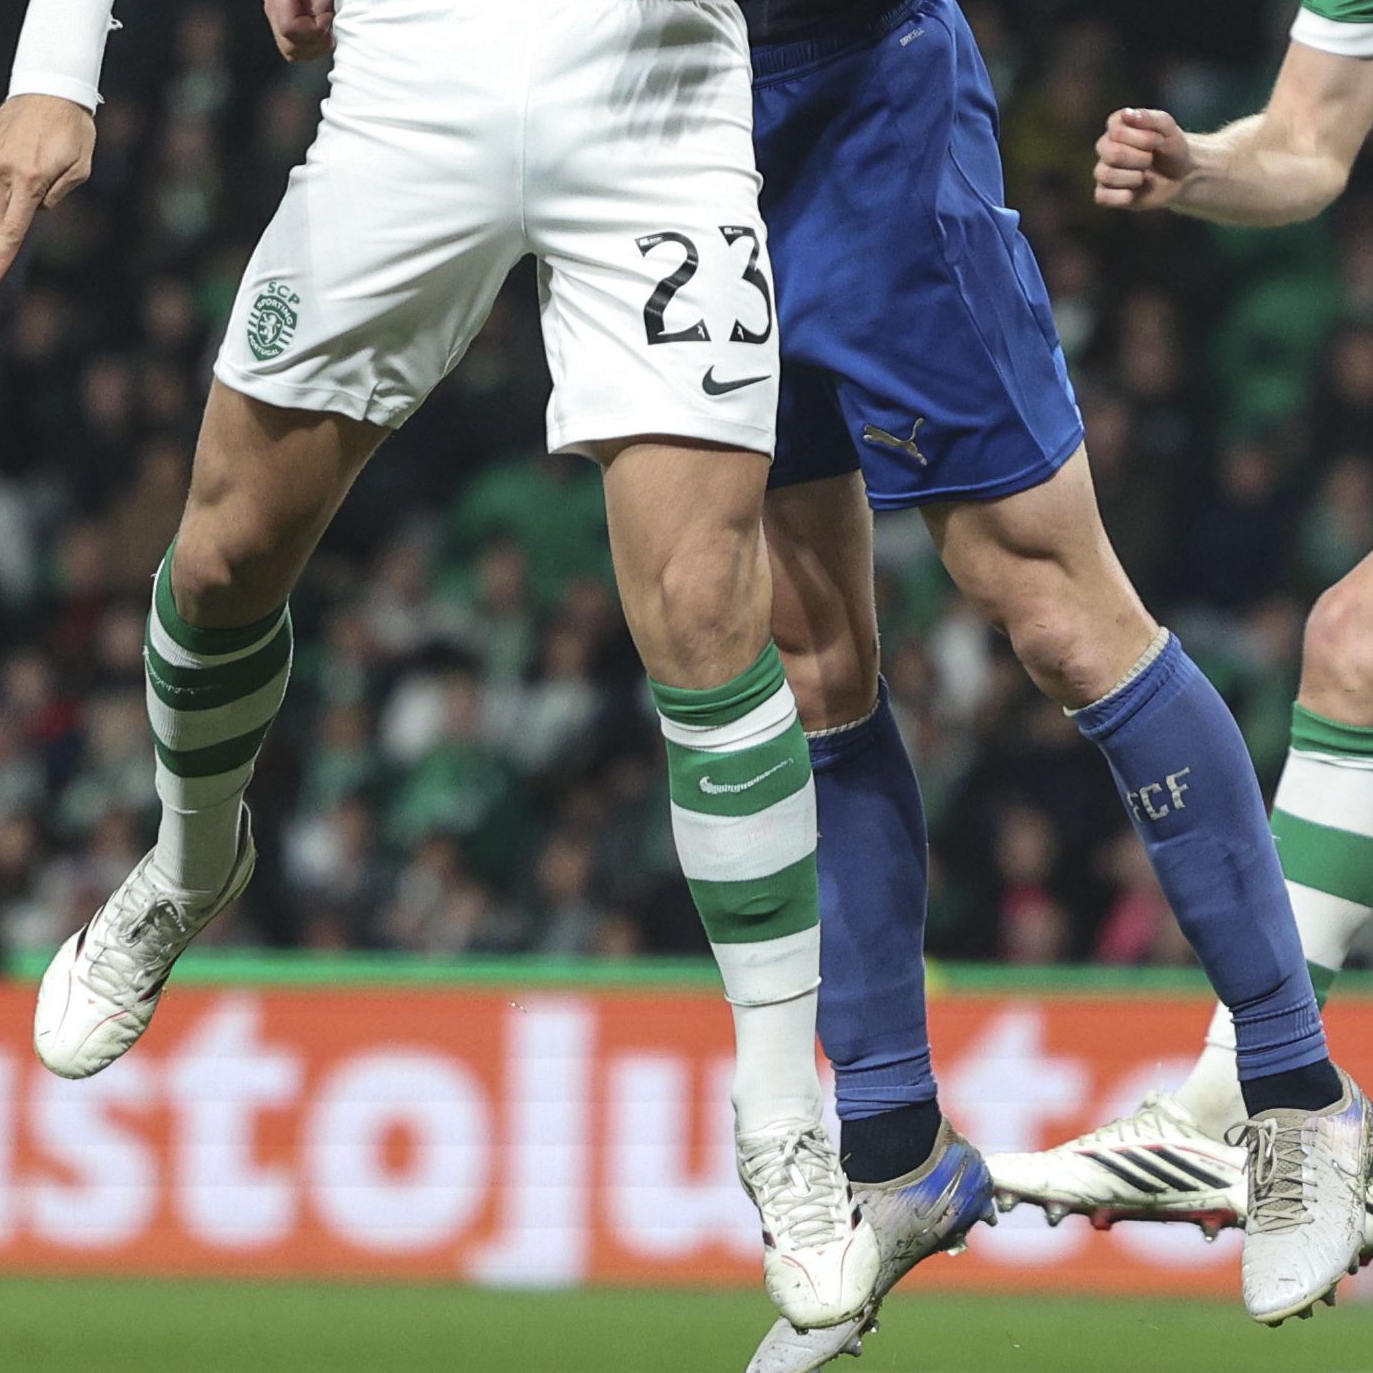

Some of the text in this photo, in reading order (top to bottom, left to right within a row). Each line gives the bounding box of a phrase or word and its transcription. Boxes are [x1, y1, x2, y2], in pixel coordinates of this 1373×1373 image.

[267, 280, 301, 305] SCP
[634, 225, 773, 346] 23
[256, 297, 294, 325] SPORTING
[1126, 766, 1191, 824] FCF
